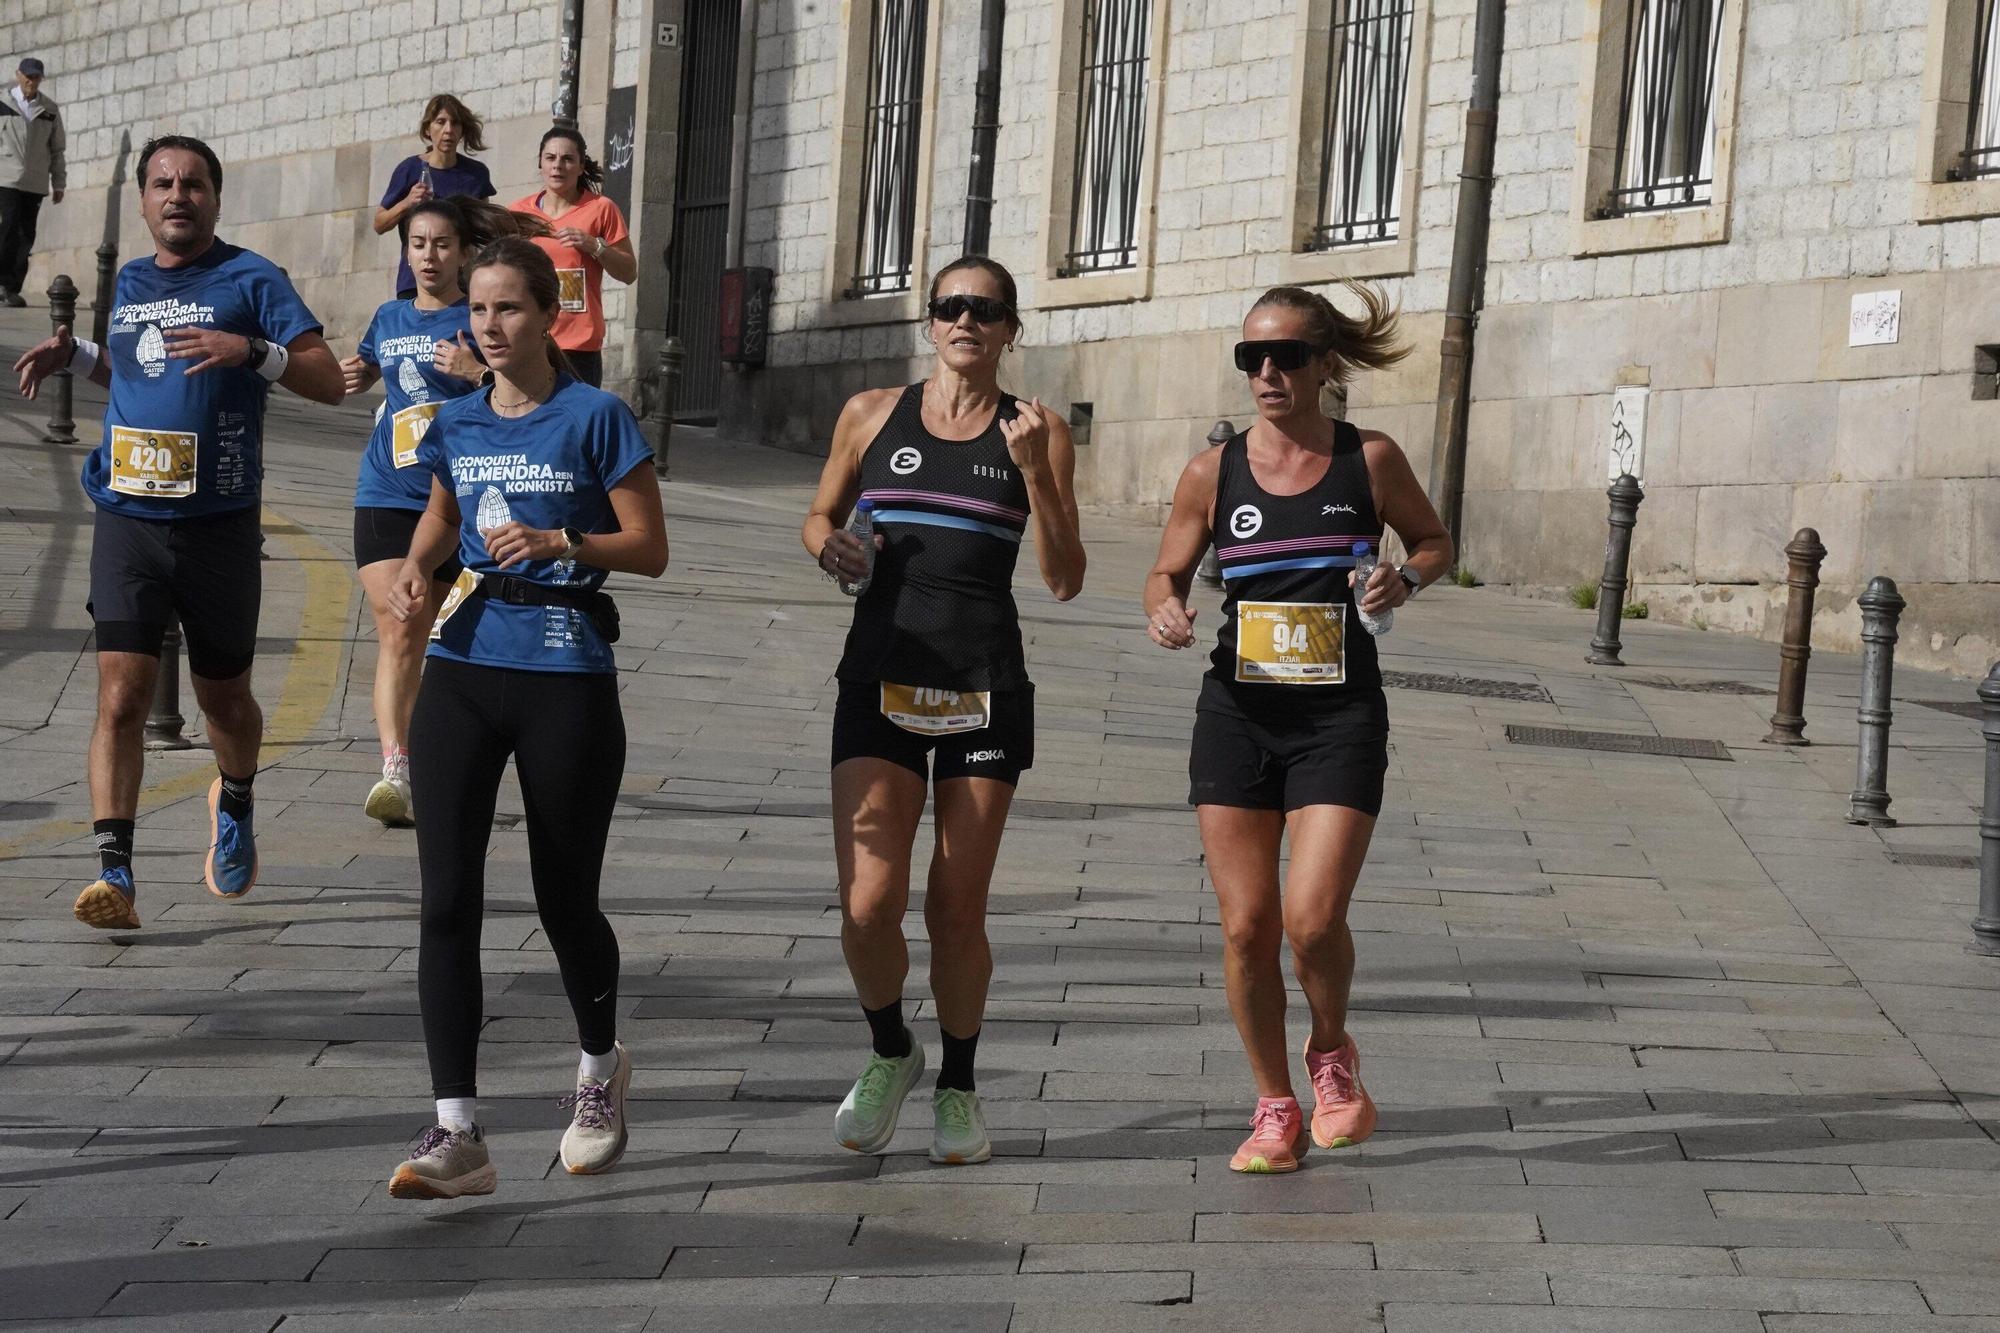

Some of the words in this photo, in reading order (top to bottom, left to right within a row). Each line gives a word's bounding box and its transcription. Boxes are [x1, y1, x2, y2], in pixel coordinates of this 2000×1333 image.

[122, 302, 198, 323] ALMENDRA
[125, 298, 179, 314] CONQUISTA
[160, 313, 215, 329] KONKISTA
[385, 335, 431, 347] CONQUISTA
[130, 446, 171, 473] 420
[458, 454, 527, 468] CONQUISTA
[459, 464, 554, 483] ALMENDRA
[555, 472, 573, 480] REN
[973, 464, 1009, 481] GOBIK
[505, 481, 574, 493] KONKISTA
[1321, 504, 1357, 515] Spiuk
[1273, 623, 1308, 654] 94
[965, 749, 1005, 763] HOKA
